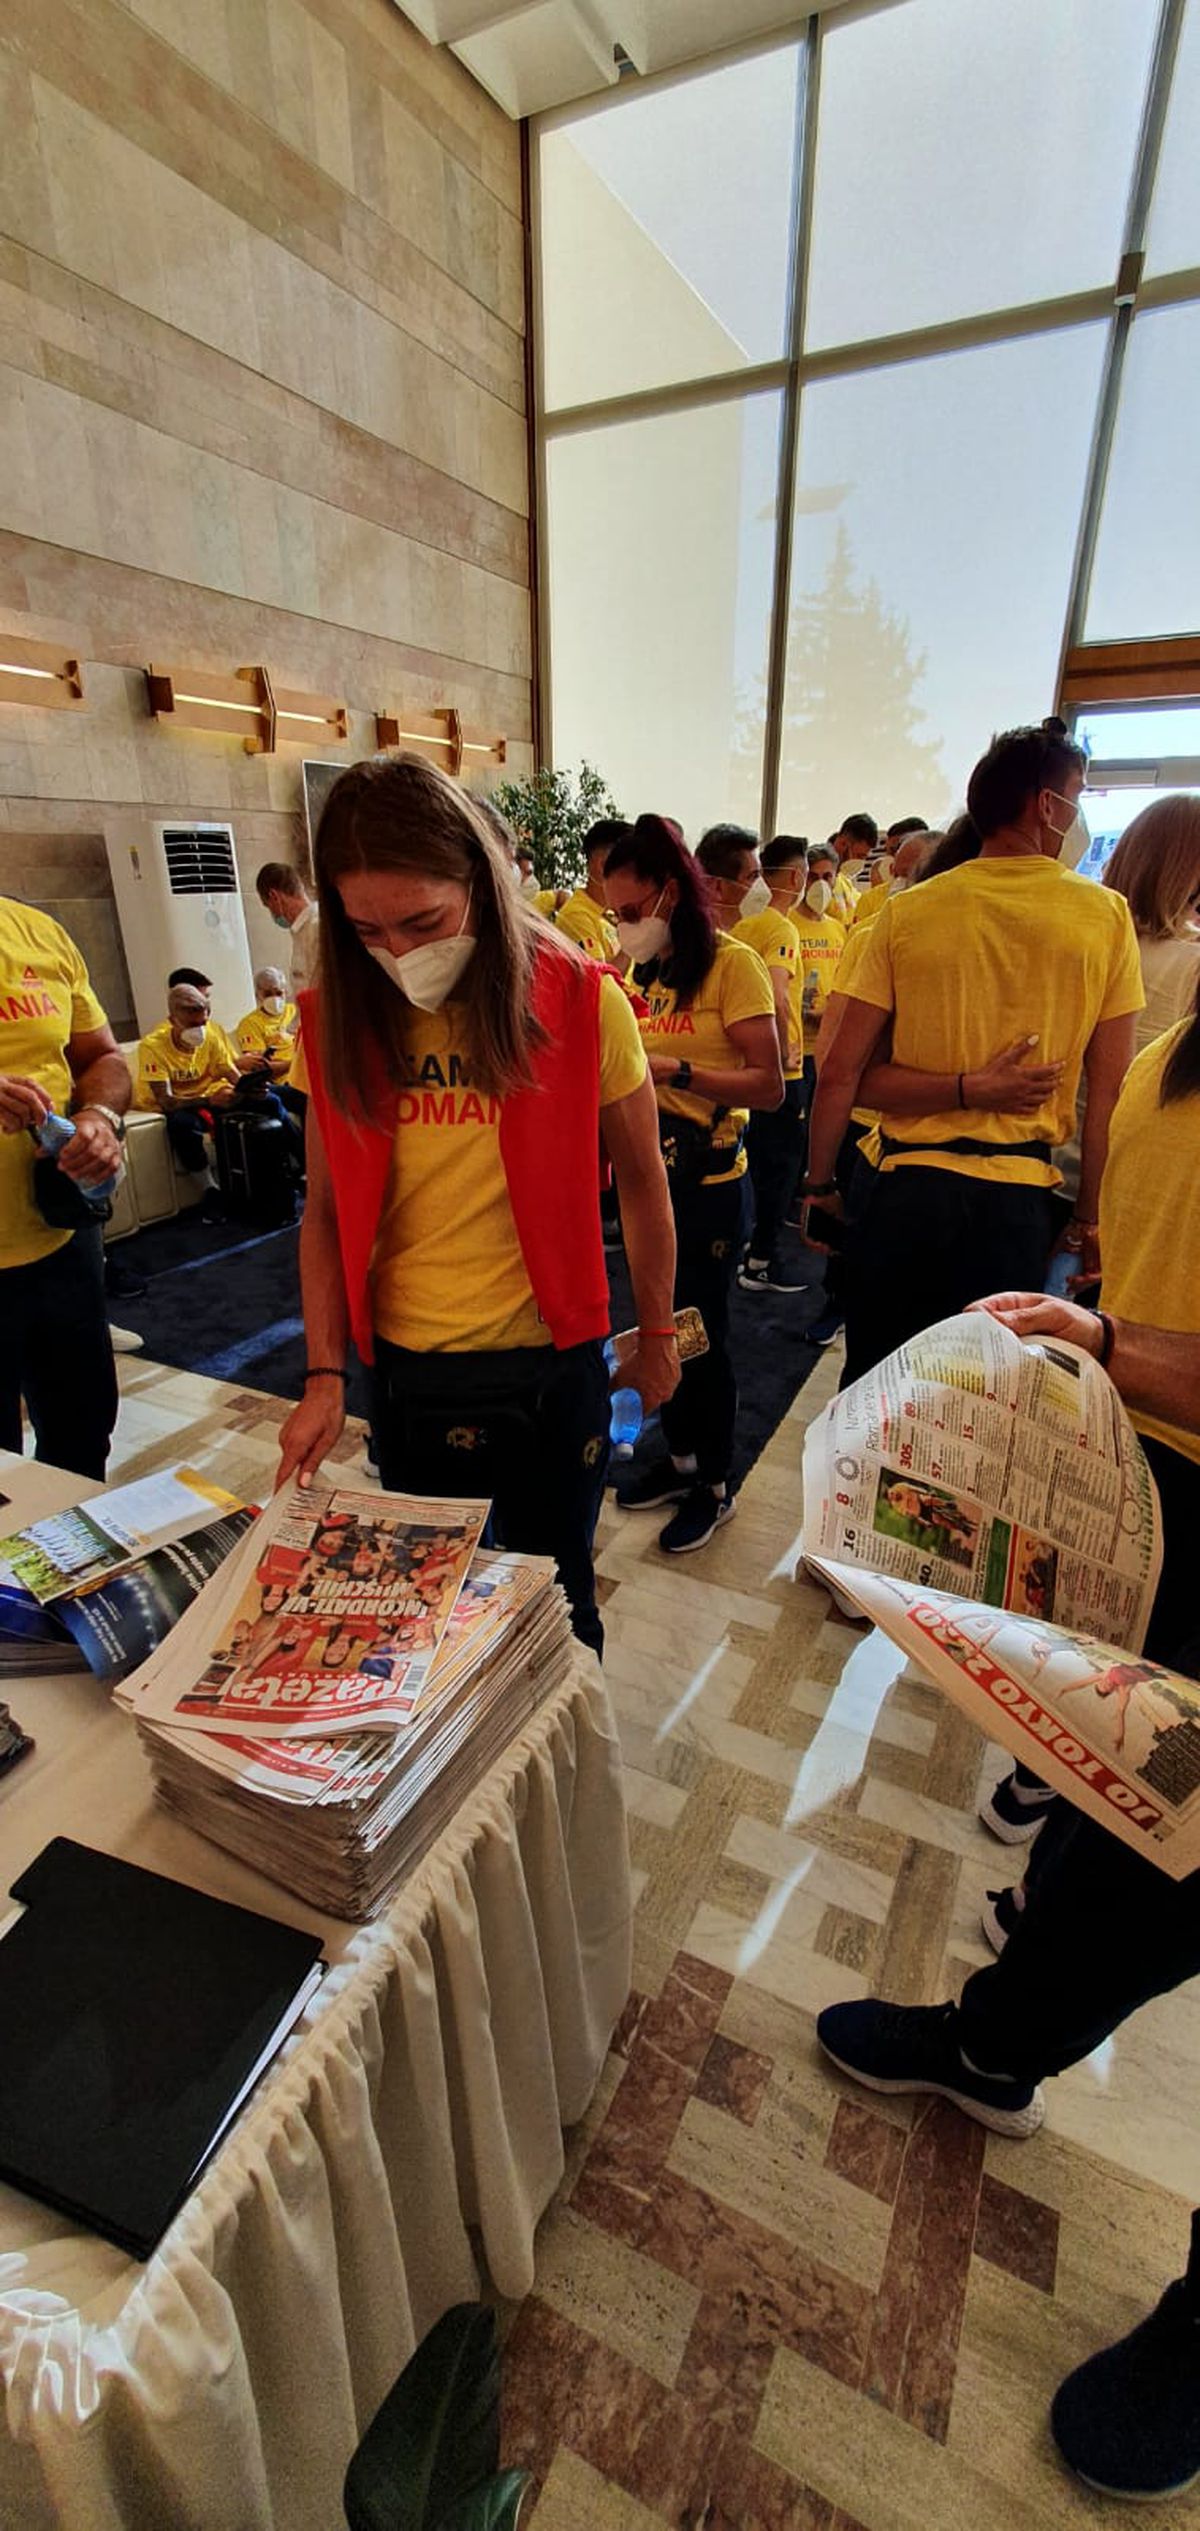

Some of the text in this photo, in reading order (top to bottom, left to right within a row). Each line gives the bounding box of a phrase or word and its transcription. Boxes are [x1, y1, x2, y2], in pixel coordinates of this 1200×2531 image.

[900, 1443, 913, 1469] 305
[931, 1461, 943, 1479] 57
[836, 1492, 850, 1506] 8
[843, 1527, 856, 1551] 16
[990, 1677, 1102, 1780] TOKYO
[1105, 1783, 1160, 1826] JO
